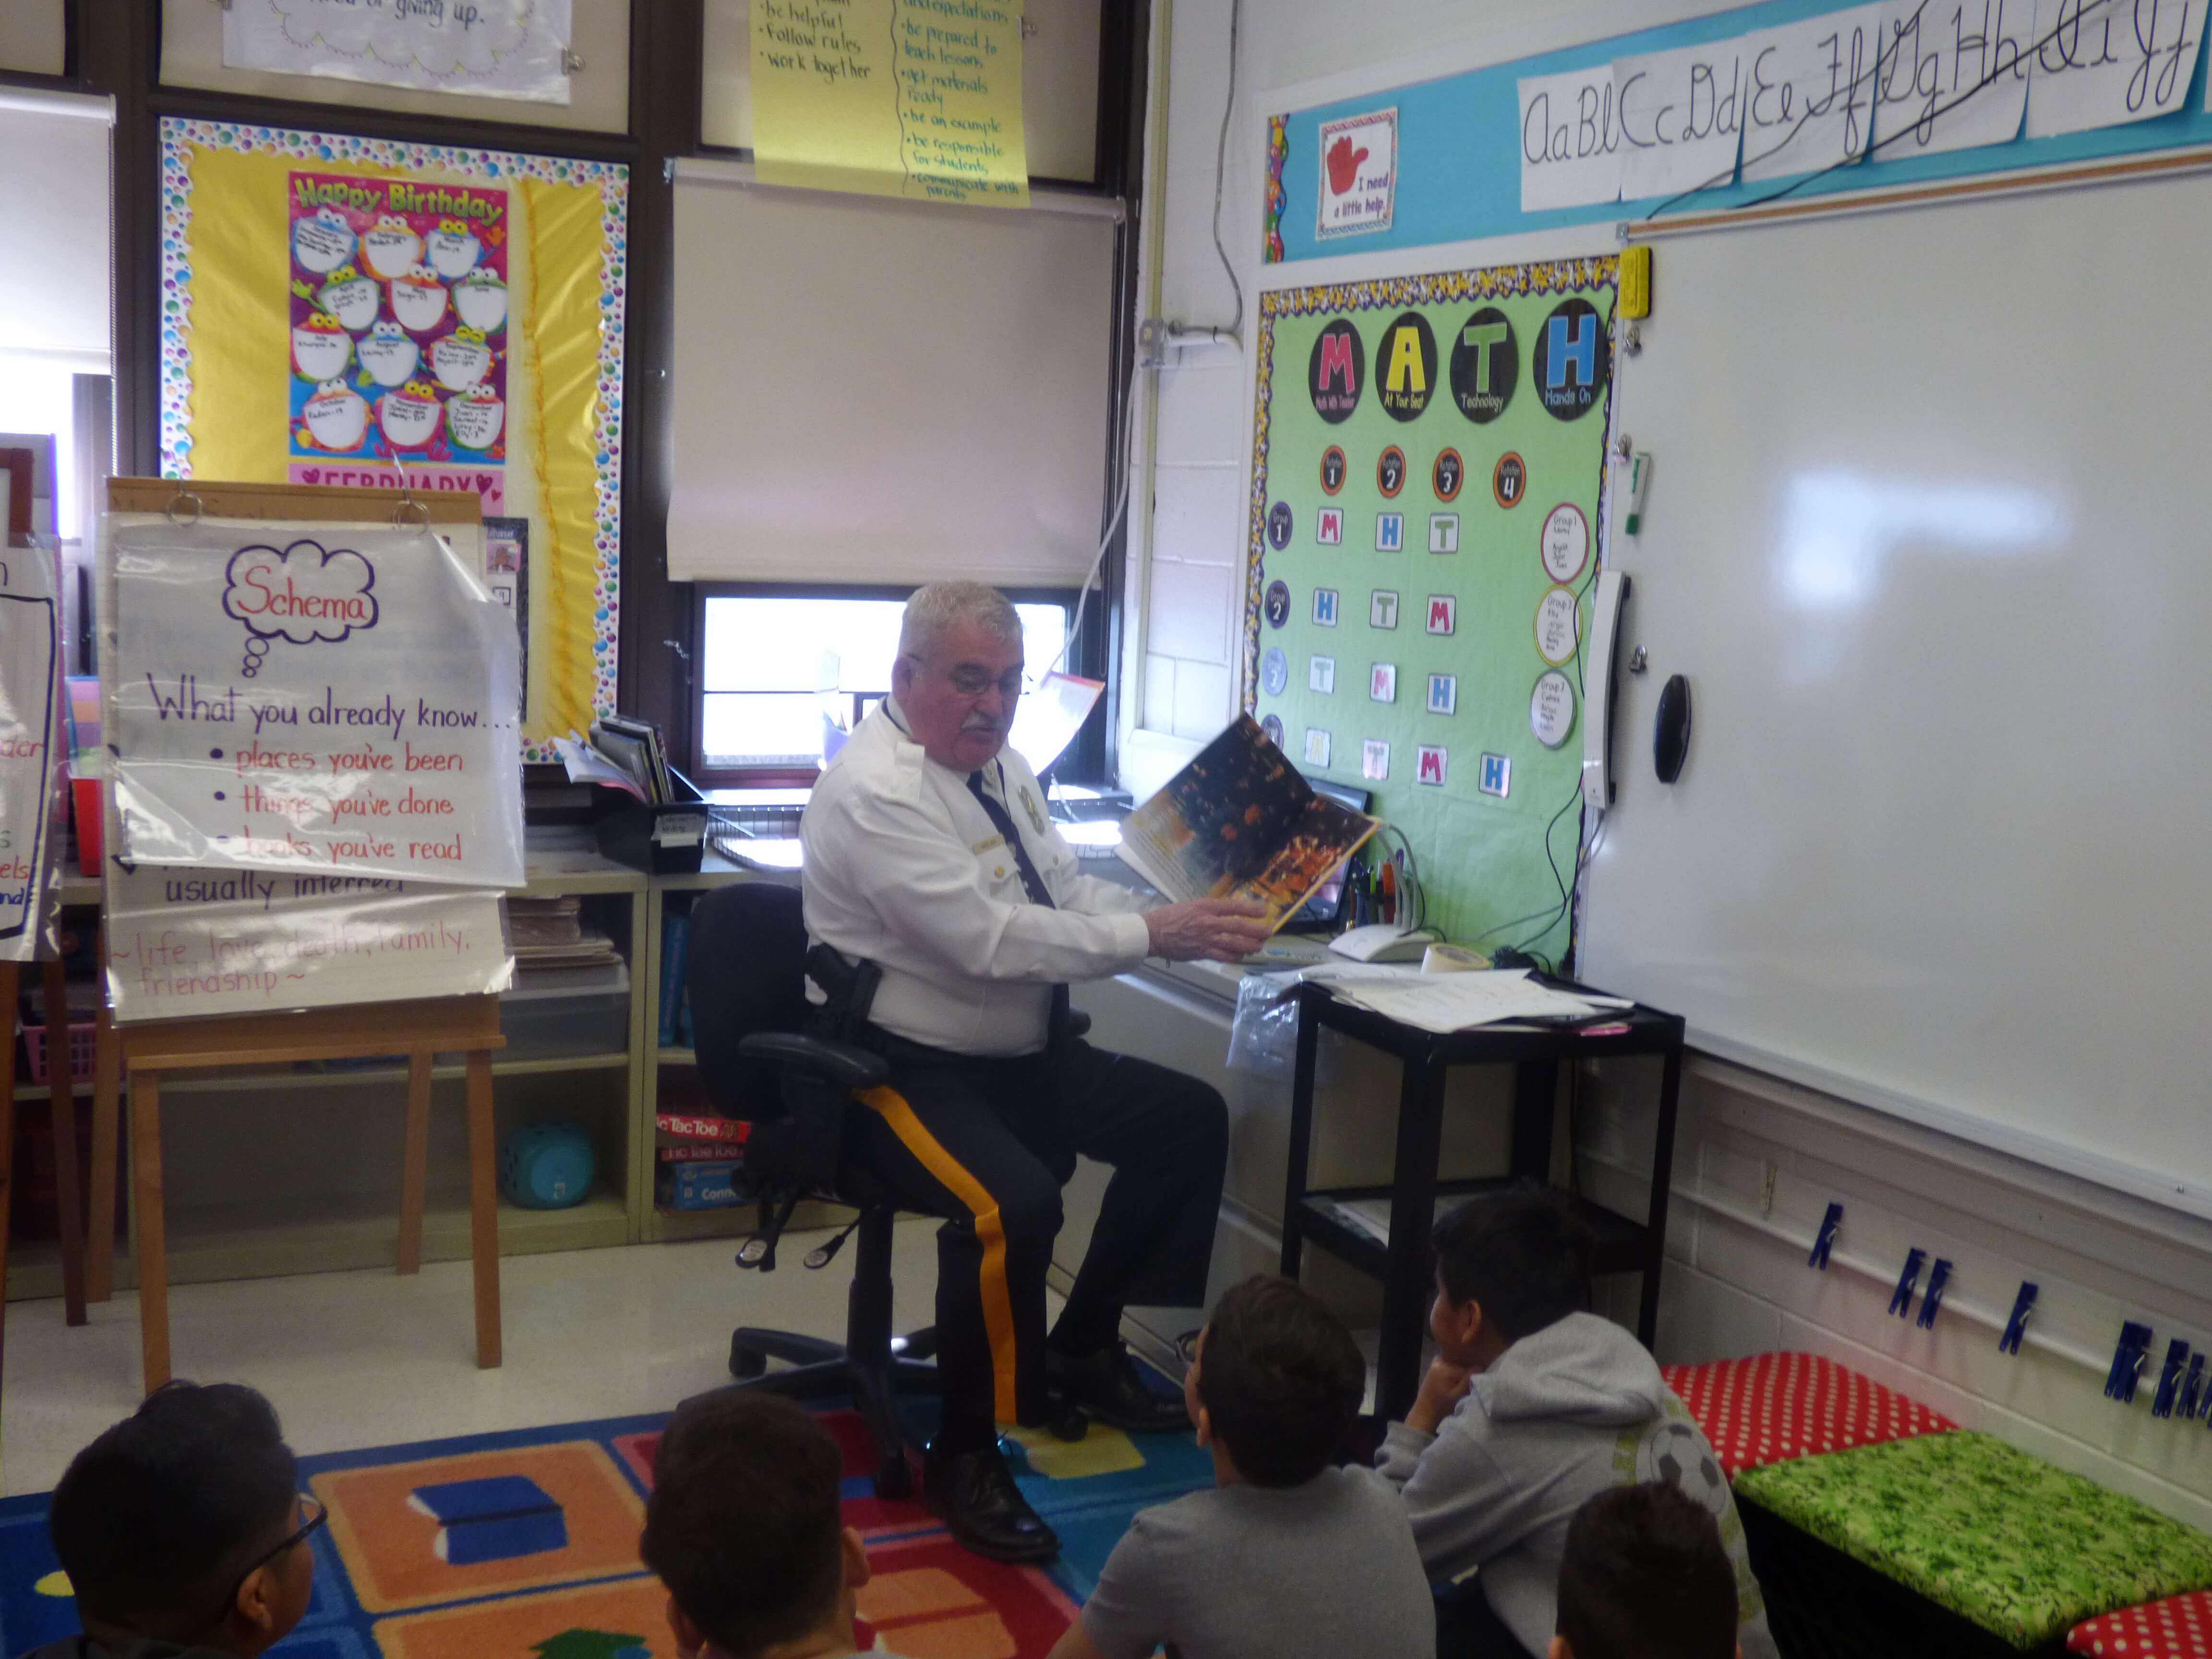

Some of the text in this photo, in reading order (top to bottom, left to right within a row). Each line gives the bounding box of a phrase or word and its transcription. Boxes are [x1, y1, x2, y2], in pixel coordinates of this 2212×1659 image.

[1367, 173, 1389, 190] need
[294, 178, 503, 227] Happy Birthday
[1342, 201, 1362, 216] little
[1384, 392, 1424, 409] At Your Seat
[1461, 393, 1503, 413] Technology
[1545, 387, 1590, 406] Hands On
[1329, 467, 1335, 485] 1
[1386, 469, 1396, 489] 2
[1443, 471, 1452, 493] 3
[1503, 477, 1515, 499] 4
[1277, 524, 1282, 542] 1
[1321, 514, 1338, 542] M
[1382, 517, 1398, 546] H
[1435, 520, 1455, 549] T
[237, 565, 368, 620] Schema
[1317, 592, 1333, 621] H
[1273, 601, 1282, 621] 2
[1377, 596, 1394, 624] T
[1430, 601, 1450, 631] M
[1373, 669, 1391, 700] M
[1432, 678, 1449, 708] H
[146, 673, 512, 741] What you already know...
[236, 740, 464, 779] places you've been
[1421, 752, 1442, 782] M
[1484, 756, 1504, 791] H
[243, 785, 454, 825] things you've done
[243, 825, 463, 865] books you've read
[165, 870, 276, 910] usually
[669, 1118, 692, 1134] Tac
[693, 1119, 719, 1136] Toe
